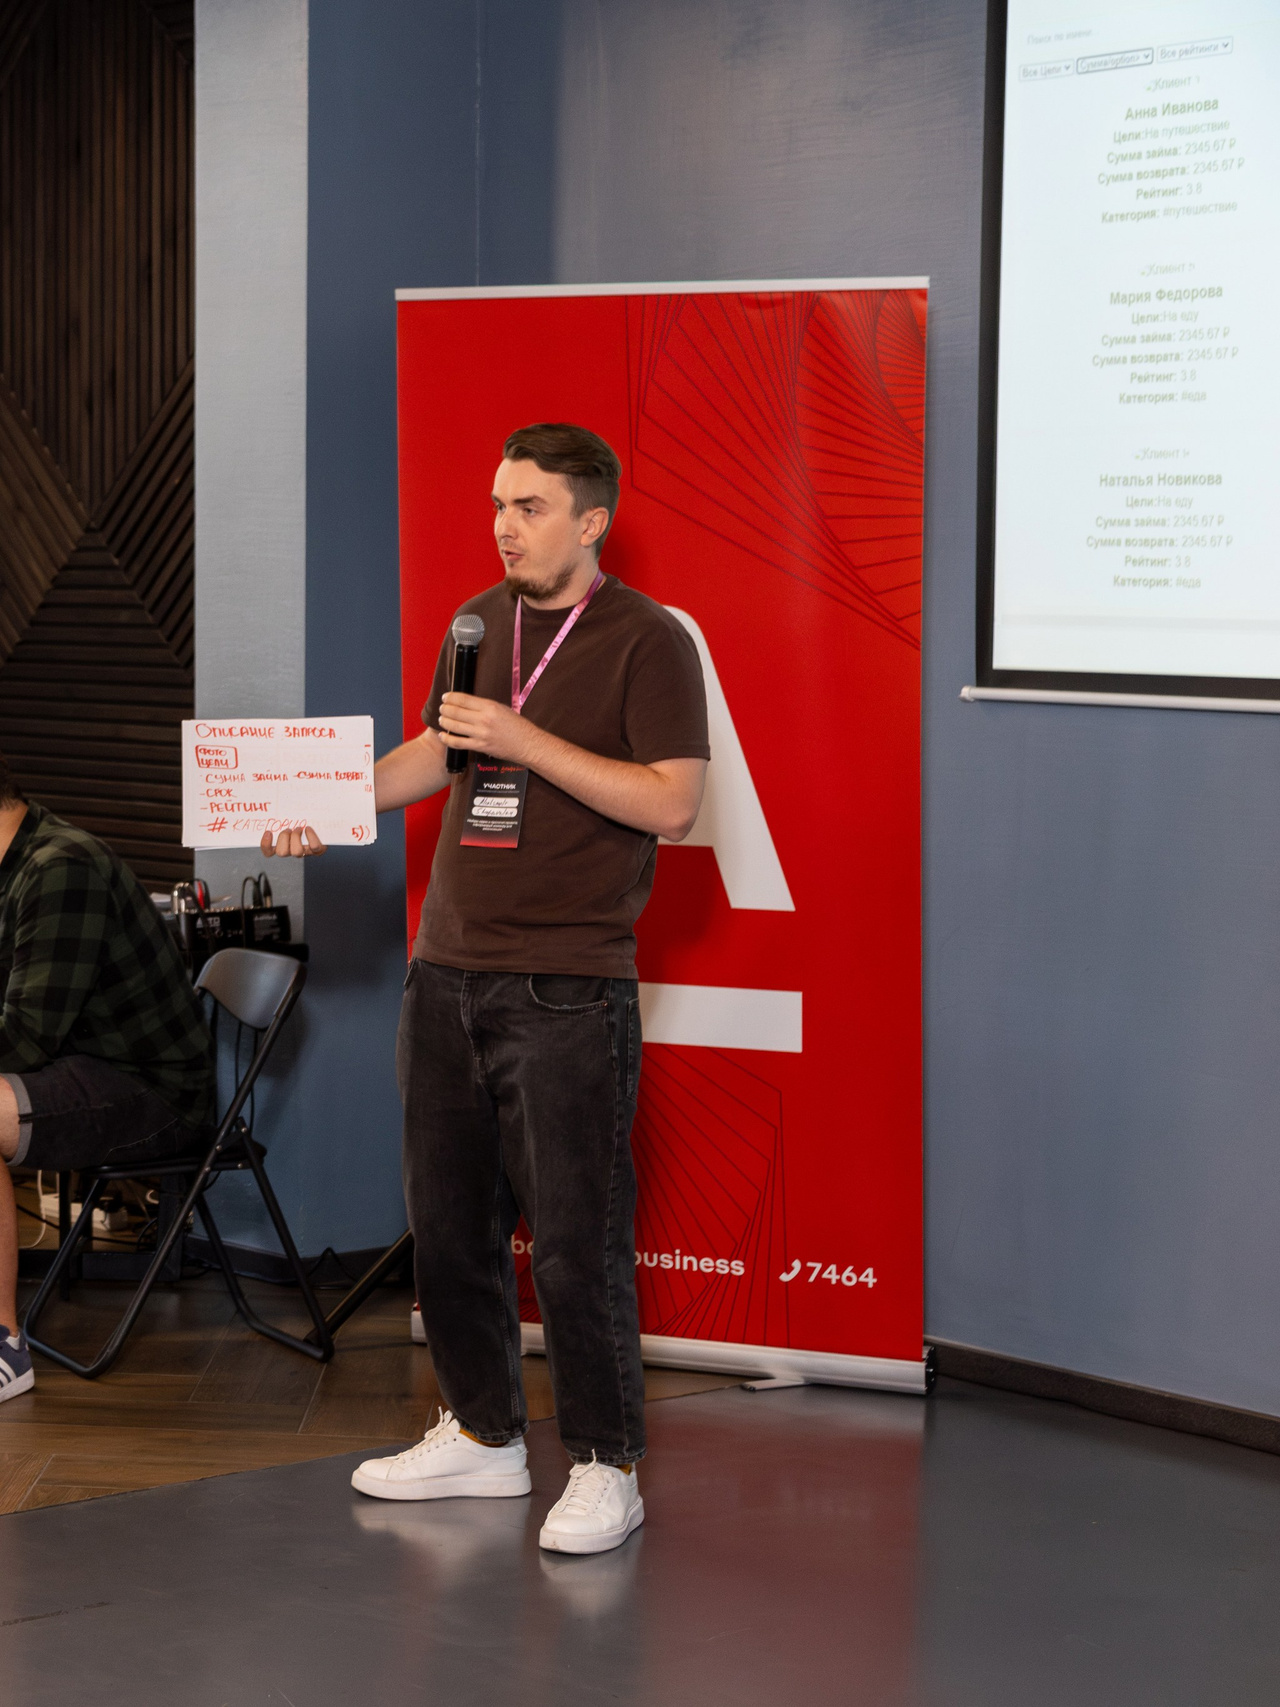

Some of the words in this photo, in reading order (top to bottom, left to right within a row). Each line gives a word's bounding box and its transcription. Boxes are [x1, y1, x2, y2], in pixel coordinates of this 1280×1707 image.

[1178, 43, 1218, 57] рейтинги
[1125, 107, 1157, 121] Анна
[1162, 99, 1219, 116] Иванова
[1162, 120, 1230, 138] путешествие
[1107, 151, 1142, 164] Сумма
[1098, 171, 1133, 185] Сумма
[1136, 165, 1190, 182] возврата:
[1136, 185, 1182, 200] Рейтинг:
[1102, 208, 1159, 223] Категория:
[1110, 290, 1151, 306] Мария
[1156, 285, 1223, 302] Федорова
[1180, 310, 1198, 323] еду
[1102, 334, 1136, 348] Сумма
[1092, 354, 1127, 368] Сумма
[1130, 351, 1184, 365] возврата:
[1130, 371, 1177, 384] Рейтинг:
[1119, 391, 1178, 405] Категория:
[1099, 474, 1153, 487] Наталья
[1157, 473, 1222, 486] Новикова
[1175, 497, 1193, 509] еду
[1096, 516, 1130, 530] Сумма
[1087, 536, 1121, 549] Сумма
[1125, 536, 1178, 548] возврата:
[1125, 555, 1171, 568] Рейтинг:
[1113, 576, 1172, 589] Категория:
[198, 748, 226, 757] ФОТО
[200, 758, 229, 768] ЦЕЛИ
[205, 773, 246, 784] СУММА
[253, 770, 288, 781] ЗАЙМА
[805, 1261, 878, 1289] 7464
